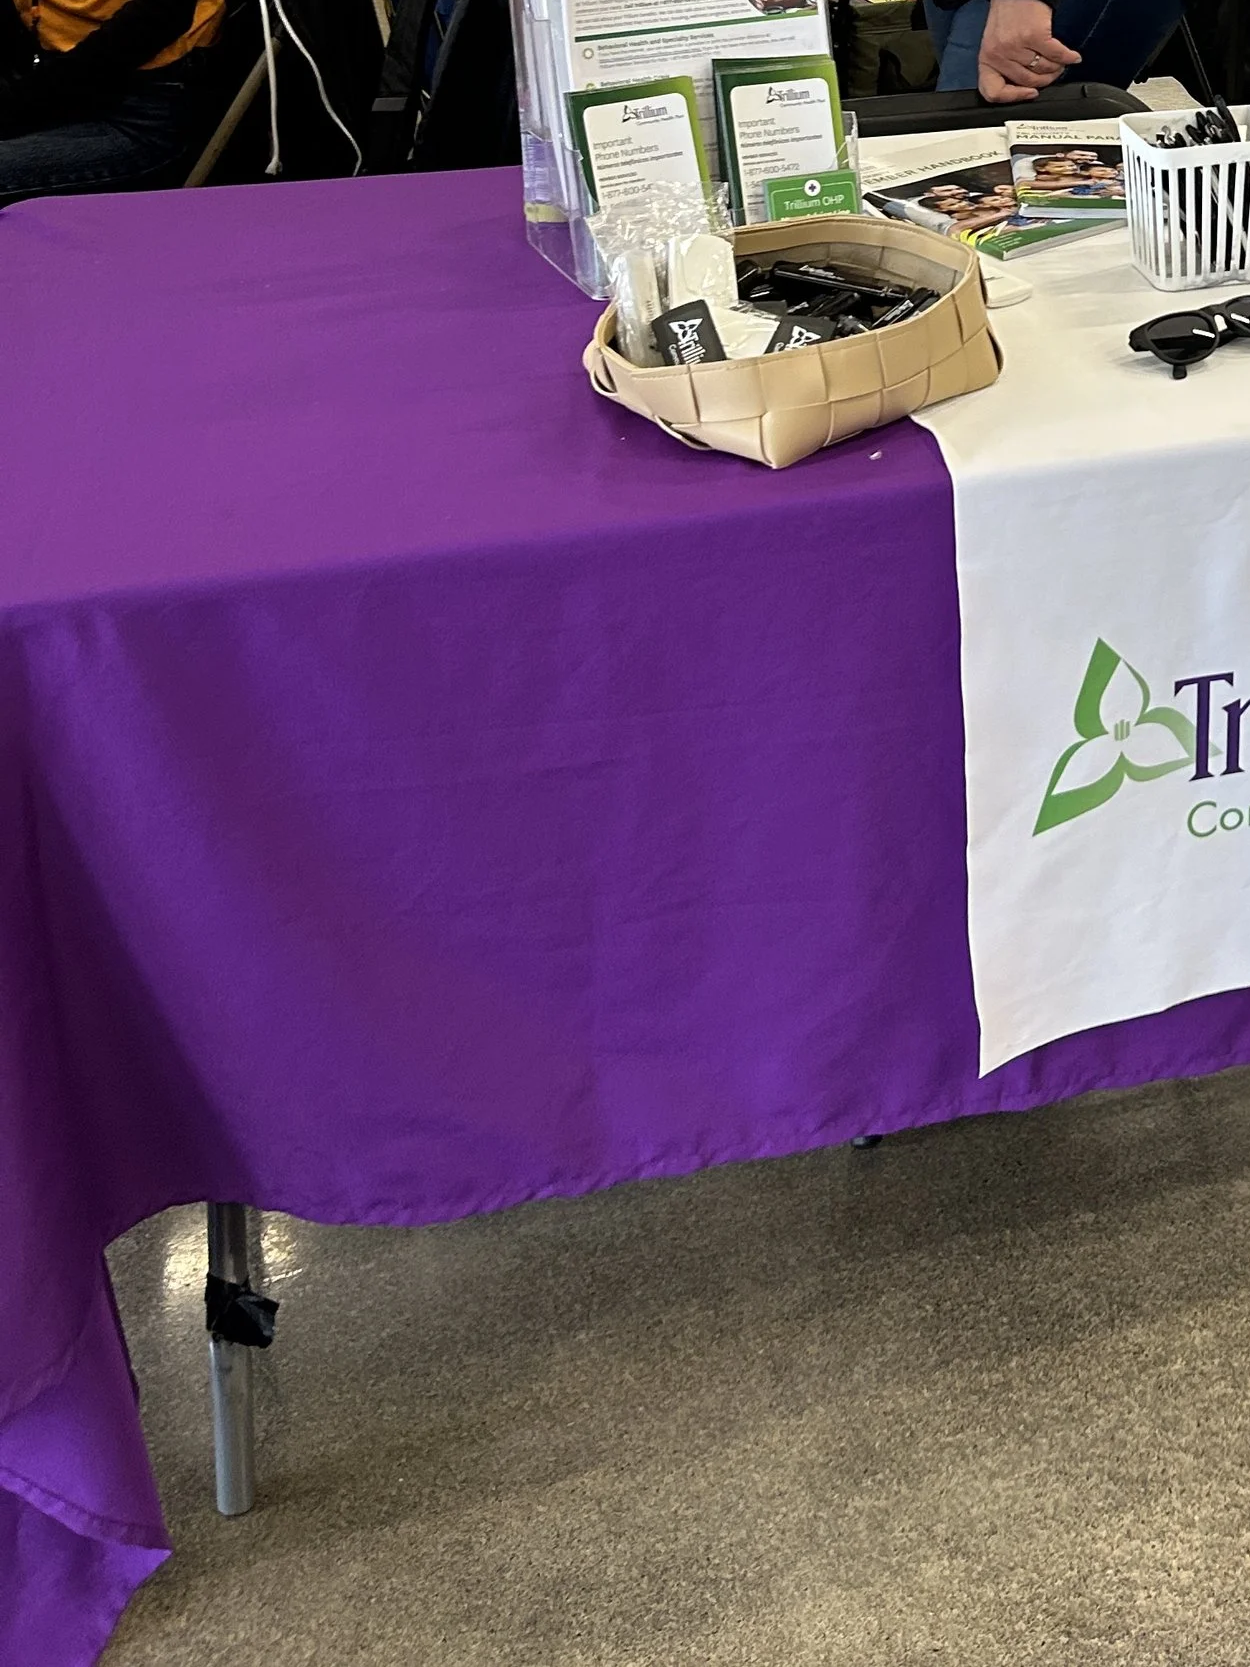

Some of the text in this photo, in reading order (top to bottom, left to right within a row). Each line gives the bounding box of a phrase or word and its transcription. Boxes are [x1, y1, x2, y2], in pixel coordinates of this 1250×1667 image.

[738, 118, 776, 129] Important
[740, 127, 800, 139] Phone Numbers
[593, 136, 633, 150] Important
[595, 145, 659, 161] Phone Numbers
[861, 150, 1002, 186] EMBER HANDBOOK
[784, 194, 845, 211] Trillium OHP
